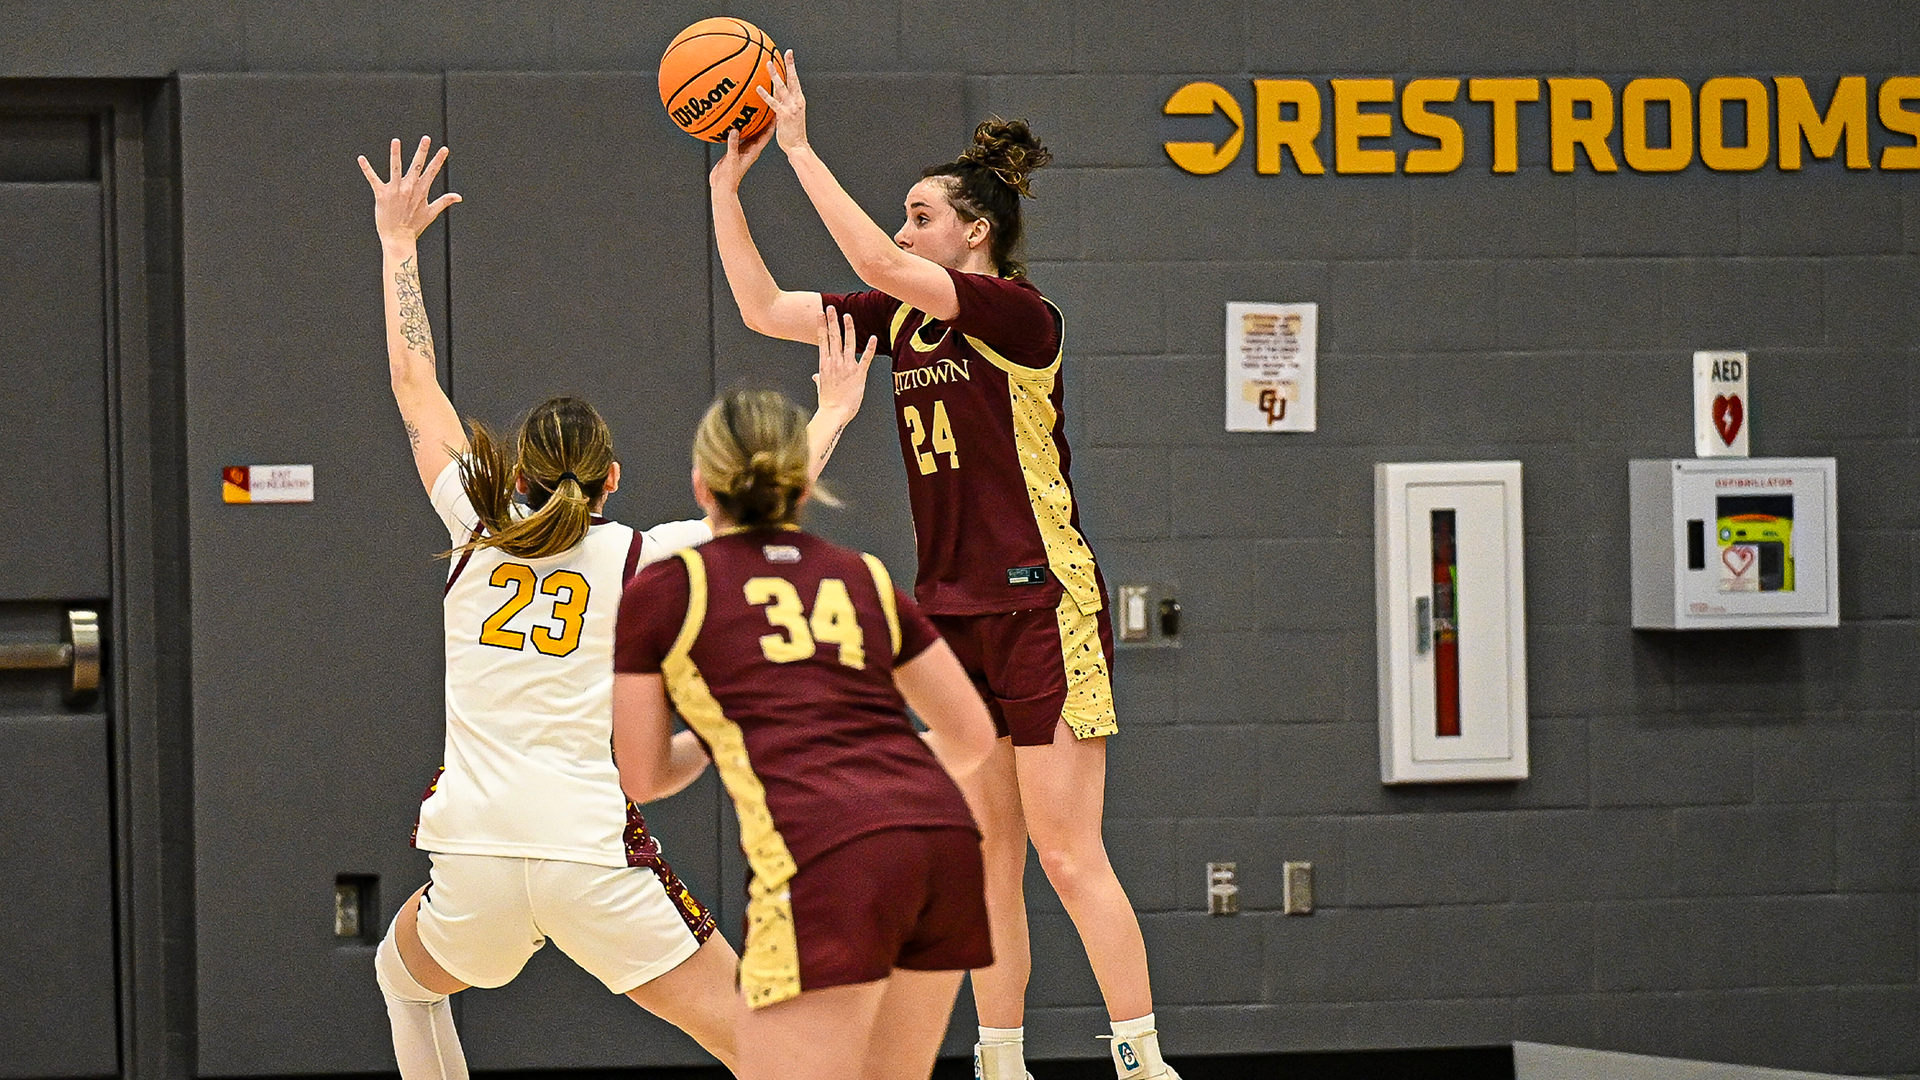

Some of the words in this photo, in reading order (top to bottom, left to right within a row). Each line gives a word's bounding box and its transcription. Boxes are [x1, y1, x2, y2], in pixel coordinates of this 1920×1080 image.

[671, 77, 737, 127] Wilson
[1253, 77, 1920, 174] RESTROOMS
[1711, 360, 1742, 382] AED
[903, 400, 960, 476] 24
[479, 562, 591, 658] 23
[743, 577, 866, 670] 34
